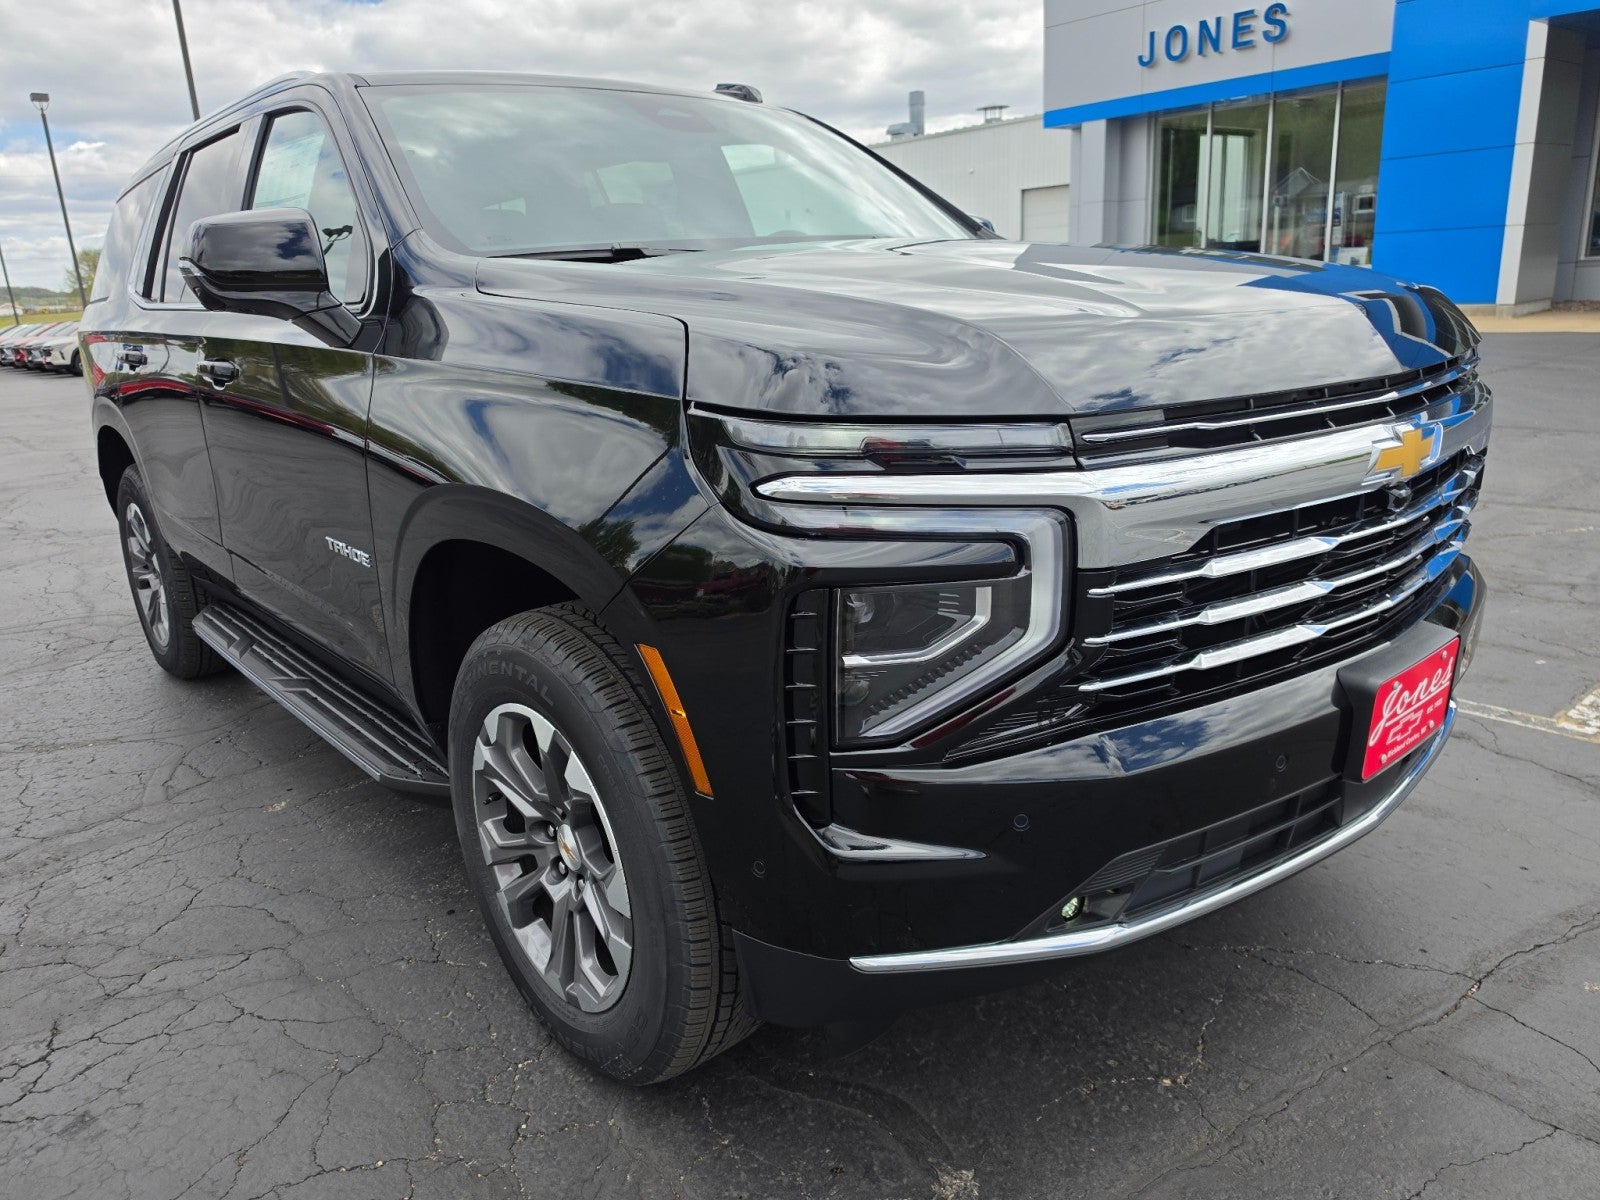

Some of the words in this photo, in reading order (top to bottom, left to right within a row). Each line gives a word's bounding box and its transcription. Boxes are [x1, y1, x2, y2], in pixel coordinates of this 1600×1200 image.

[1137, 2, 1290, 68] JONES
[325, 536, 371, 568] TAHOE
[1368, 656, 1454, 747] Jones
